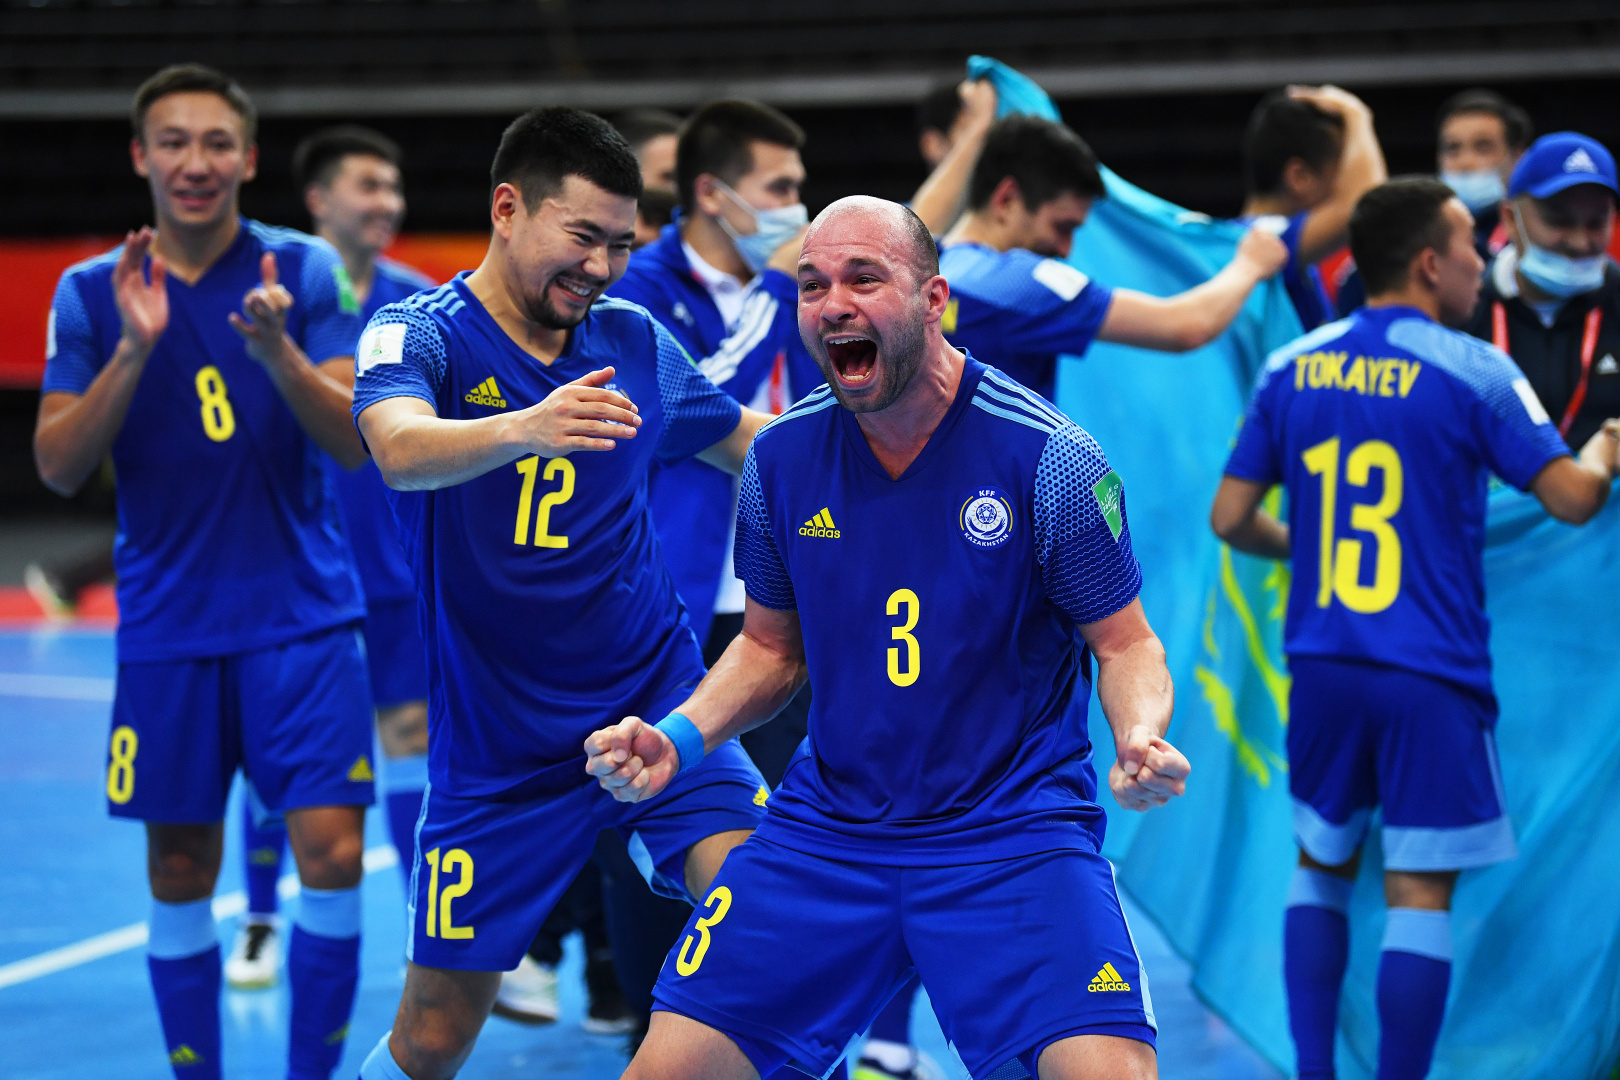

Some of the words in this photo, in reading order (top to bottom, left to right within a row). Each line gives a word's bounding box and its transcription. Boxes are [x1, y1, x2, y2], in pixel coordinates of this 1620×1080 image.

[195, 366, 236, 442] 8
[465, 393, 507, 408] adidas
[1294, 351, 1421, 398] TOKAYEV
[514, 455, 576, 549] 12
[798, 526, 841, 539] adidas
[964, 532, 1009, 547] KAZAKHSTAN
[1302, 436, 1403, 614] 13
[886, 588, 921, 687] 3
[107, 725, 138, 804] 8
[425, 847, 475, 940] 12
[676, 886, 733, 977] 3
[1087, 980, 1131, 993] adidas
